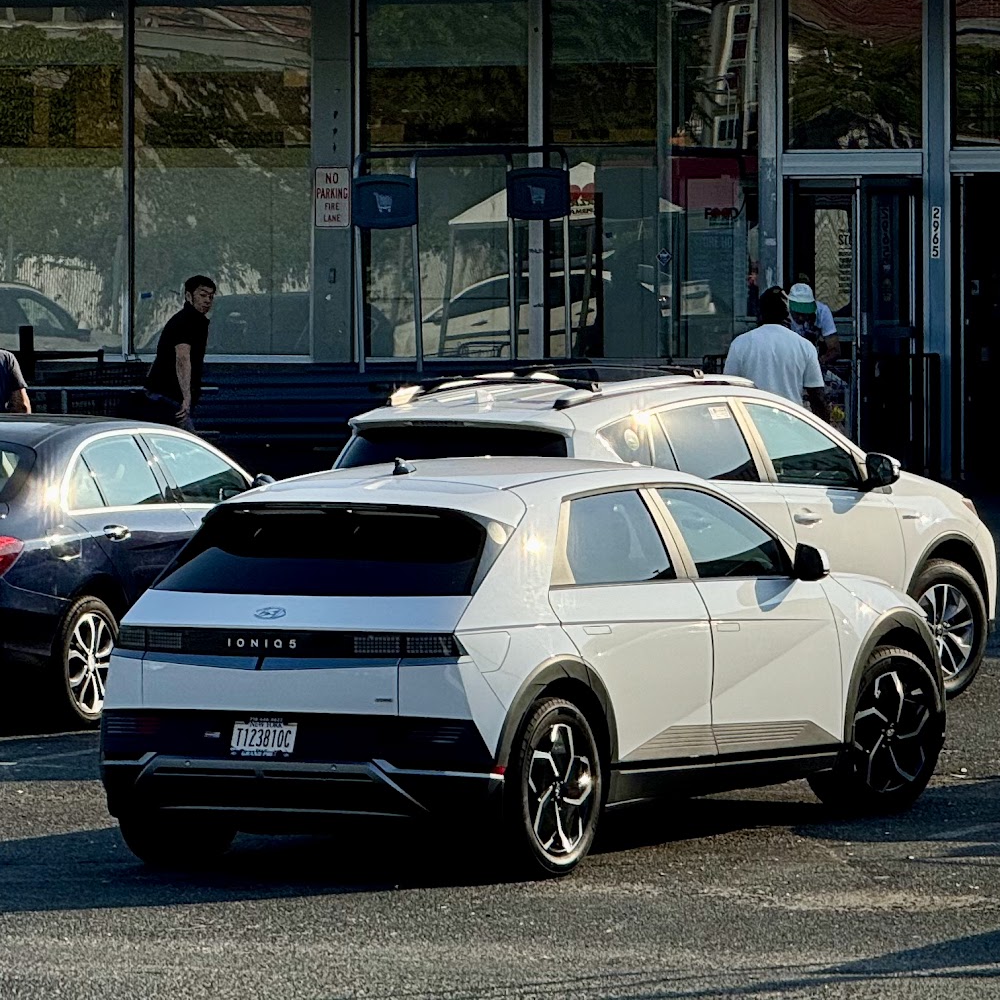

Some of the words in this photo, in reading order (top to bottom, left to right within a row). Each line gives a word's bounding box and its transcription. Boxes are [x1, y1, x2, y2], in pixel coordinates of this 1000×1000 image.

[325, 172, 339, 184] NO
[316, 187, 348, 199] PARKING
[324, 202, 340, 211] FIRE
[323, 214, 341, 222] LANE
[931, 206, 941, 258] 2965
[227, 637, 283, 649] IONIQ
[289, 639, 297, 649] 5
[236, 728, 292, 748] T123810C
